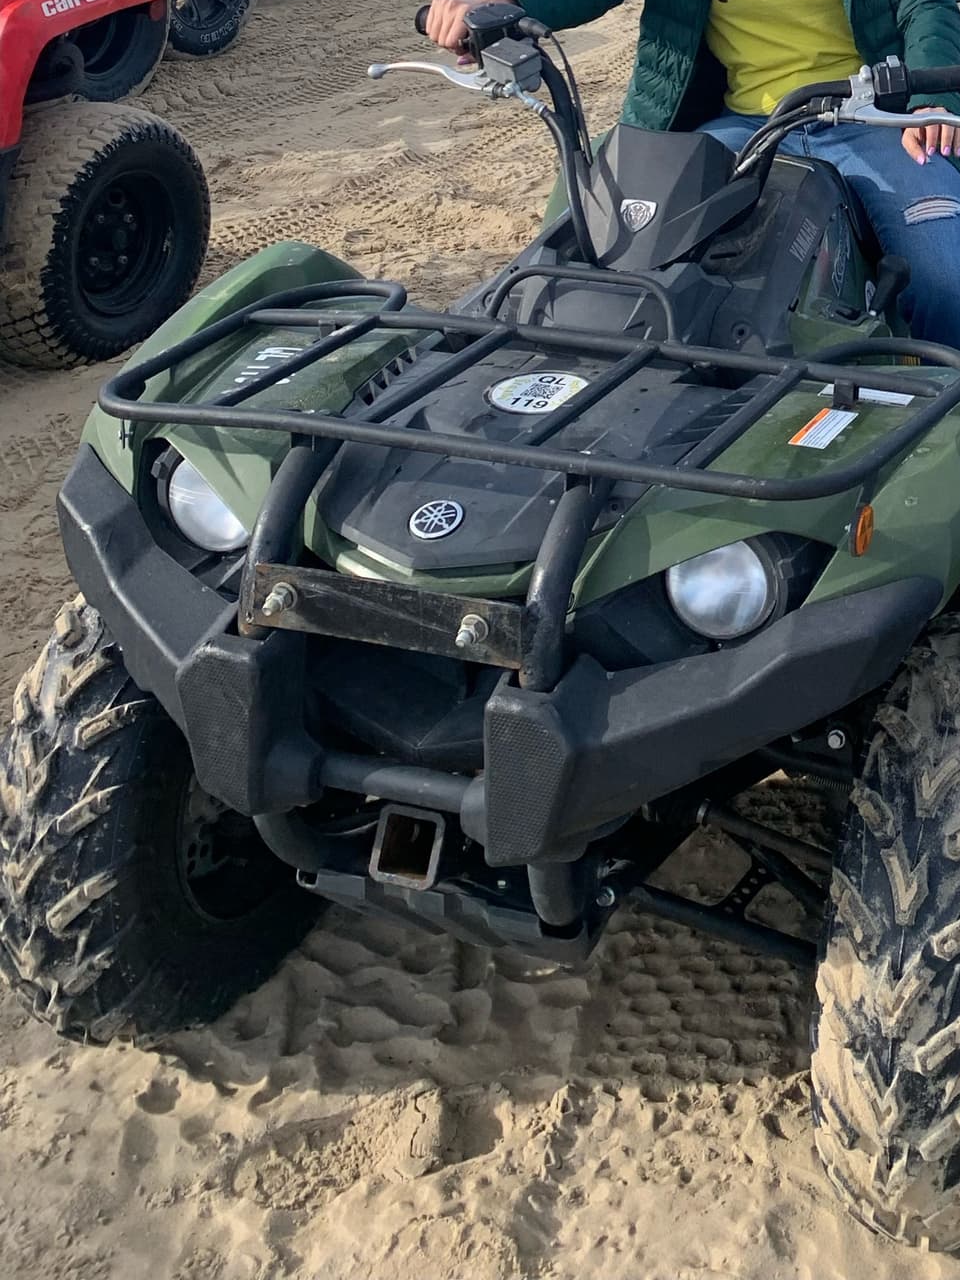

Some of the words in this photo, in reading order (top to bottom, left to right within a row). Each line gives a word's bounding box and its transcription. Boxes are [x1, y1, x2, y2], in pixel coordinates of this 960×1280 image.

[789, 217, 820, 263] YAMAHA
[538, 375, 566, 386] QL
[510, 397, 549, 409] 119
